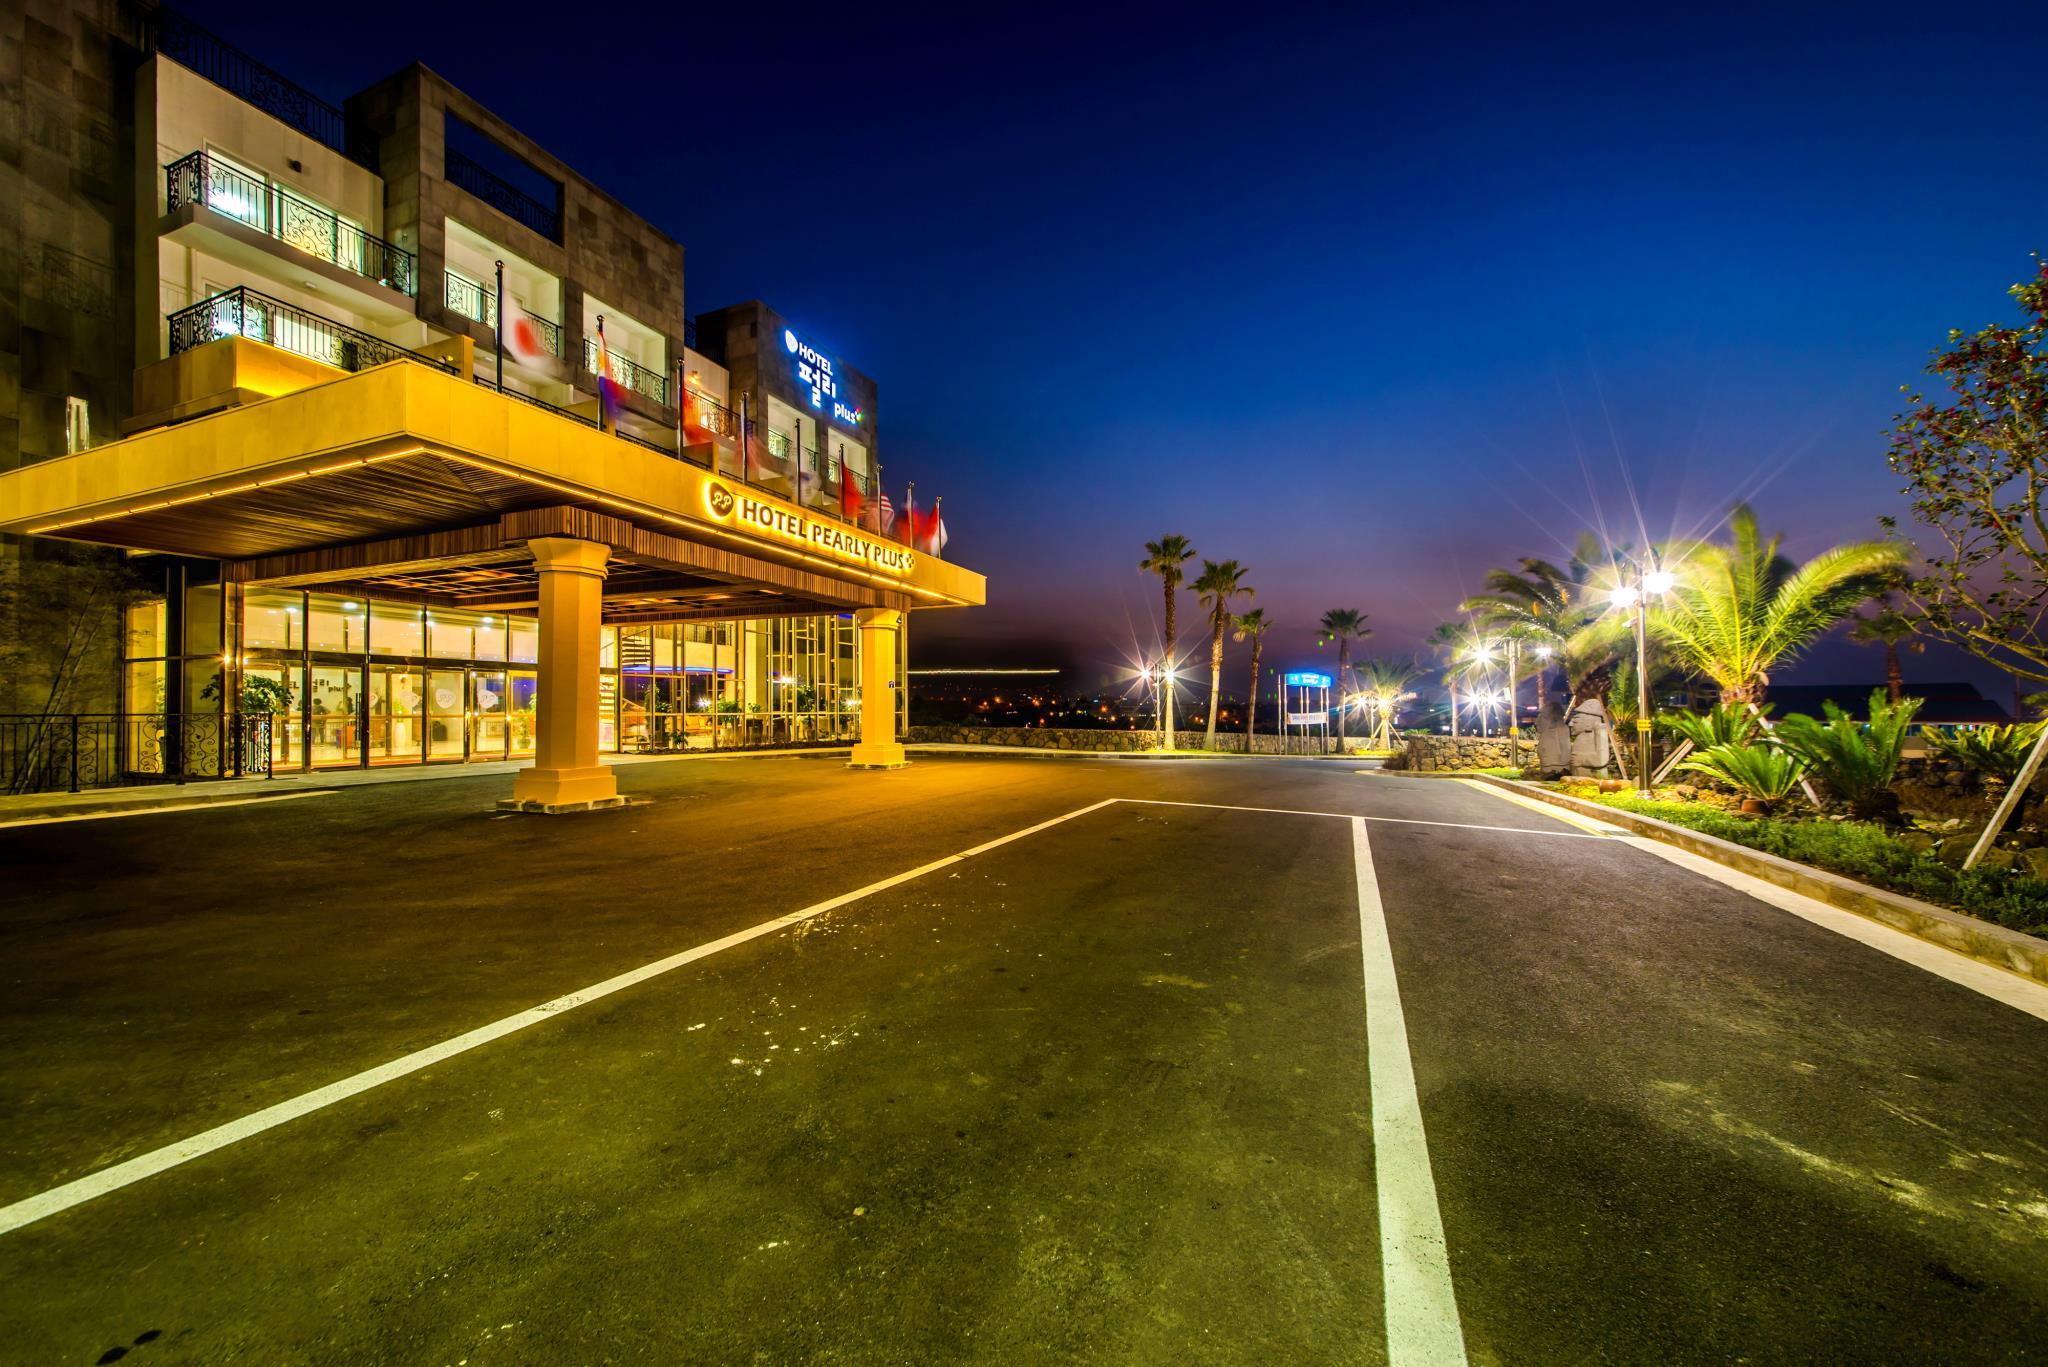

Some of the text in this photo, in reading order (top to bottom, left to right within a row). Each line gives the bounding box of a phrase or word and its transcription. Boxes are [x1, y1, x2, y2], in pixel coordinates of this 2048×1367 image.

[799, 343, 833, 376] HOTEL
[799, 362, 836, 408] 펄리
[834, 402, 856, 425] plus
[743, 498, 904, 569] HOTEL PEARLY PLUS
